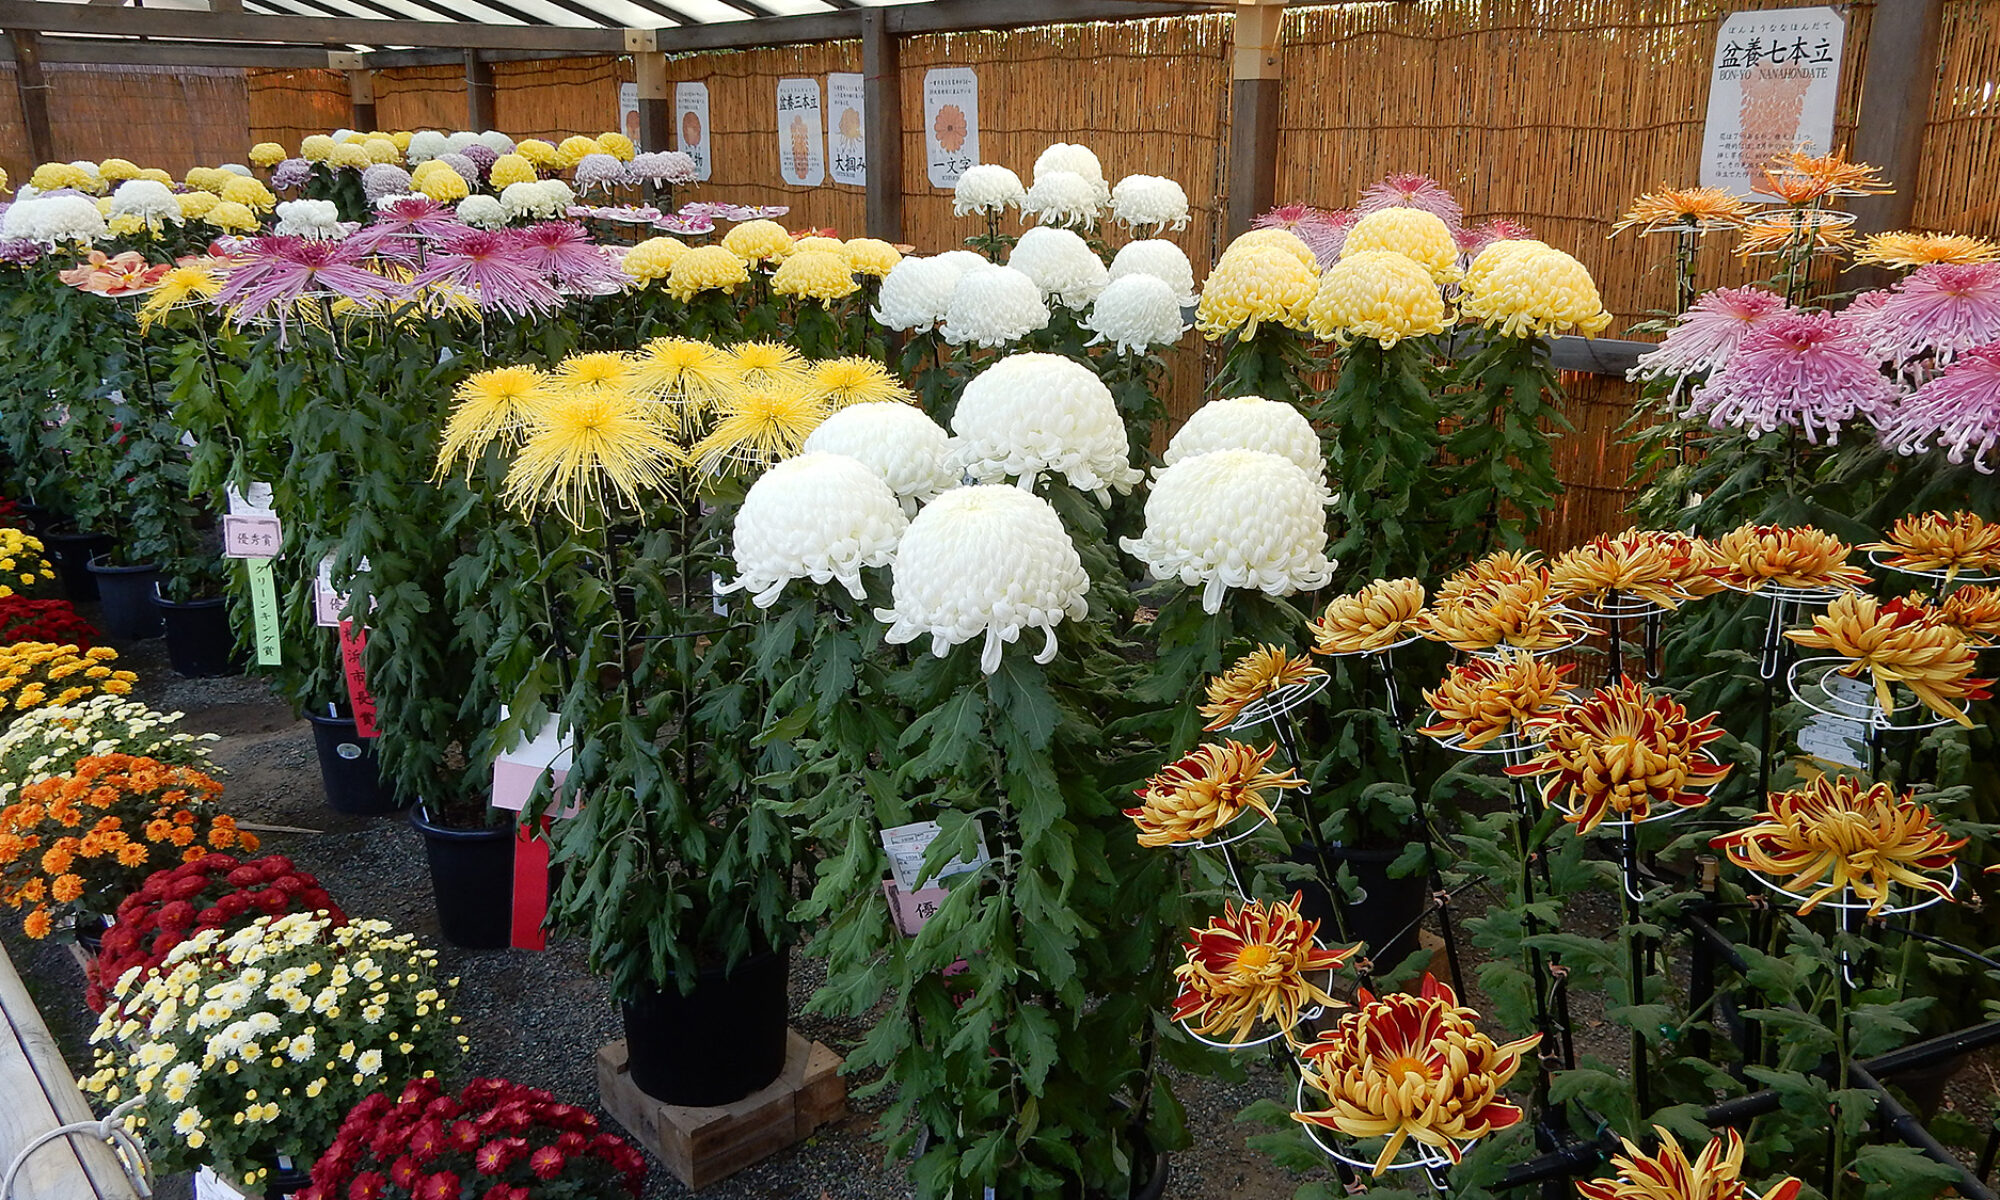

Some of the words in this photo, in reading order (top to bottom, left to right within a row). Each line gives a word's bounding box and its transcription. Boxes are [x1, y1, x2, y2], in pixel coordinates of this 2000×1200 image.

[1717, 36, 1833, 69] 盆養七本立
[1719, 69, 1752, 81] BON-YO
[1759, 67, 1828, 81] NANAHONDATE
[779, 94, 818, 111] 盆養三本立
[933, 156, 972, 175] 一文字
[237, 532, 272, 547] 優秀賞
[255, 564, 275, 657] グリーンキング賞
